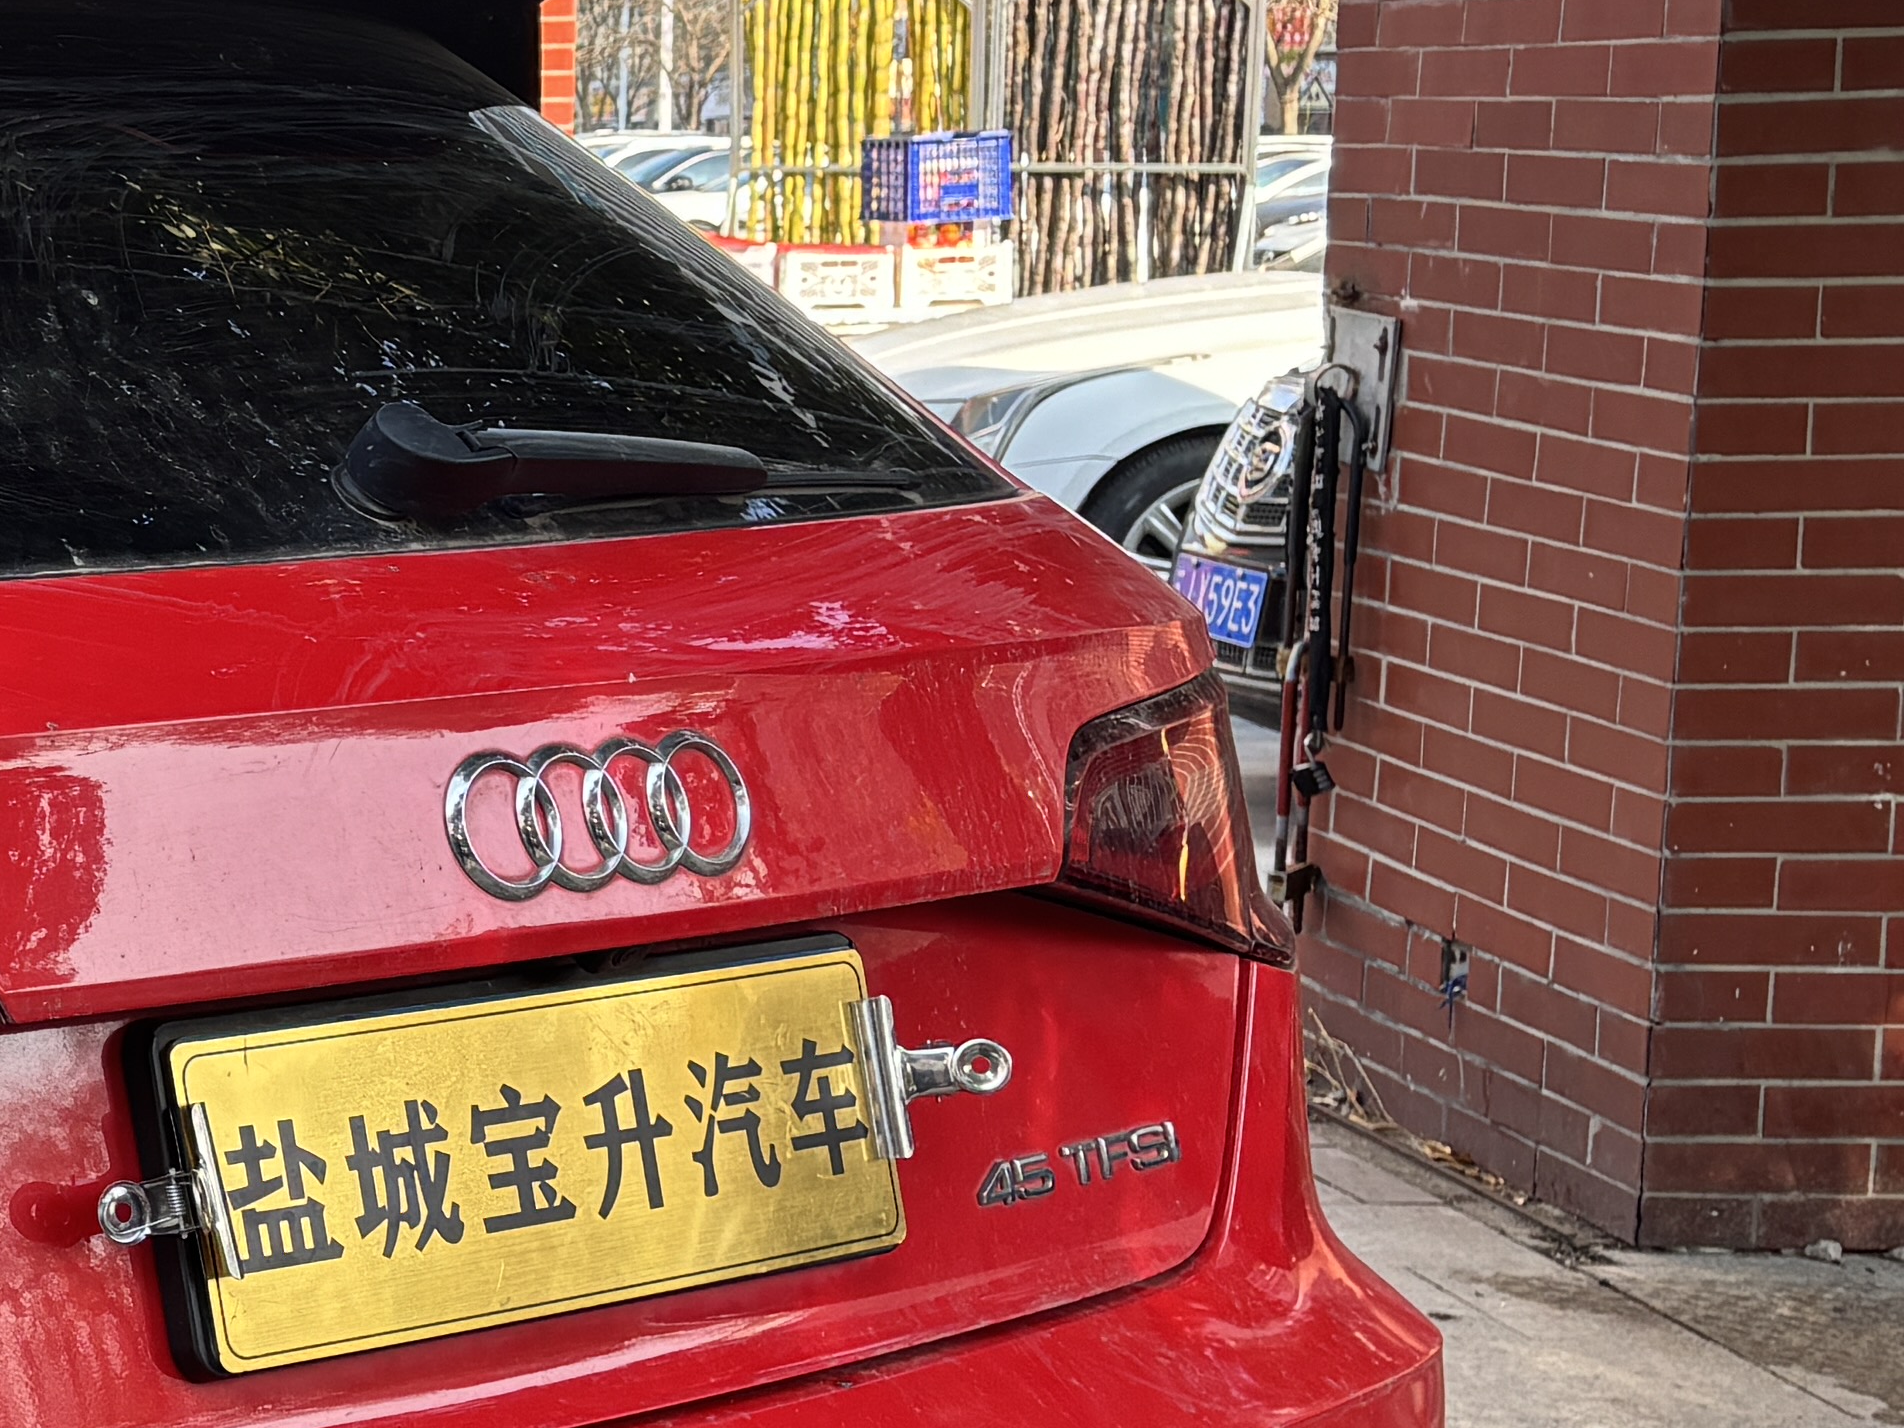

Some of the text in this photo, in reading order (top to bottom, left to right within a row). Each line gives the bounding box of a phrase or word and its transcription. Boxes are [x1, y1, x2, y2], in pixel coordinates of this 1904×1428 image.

[224, 1037, 869, 1275] 盐城宝升汽车
[976, 1120, 1182, 1207] 45 TFSI
